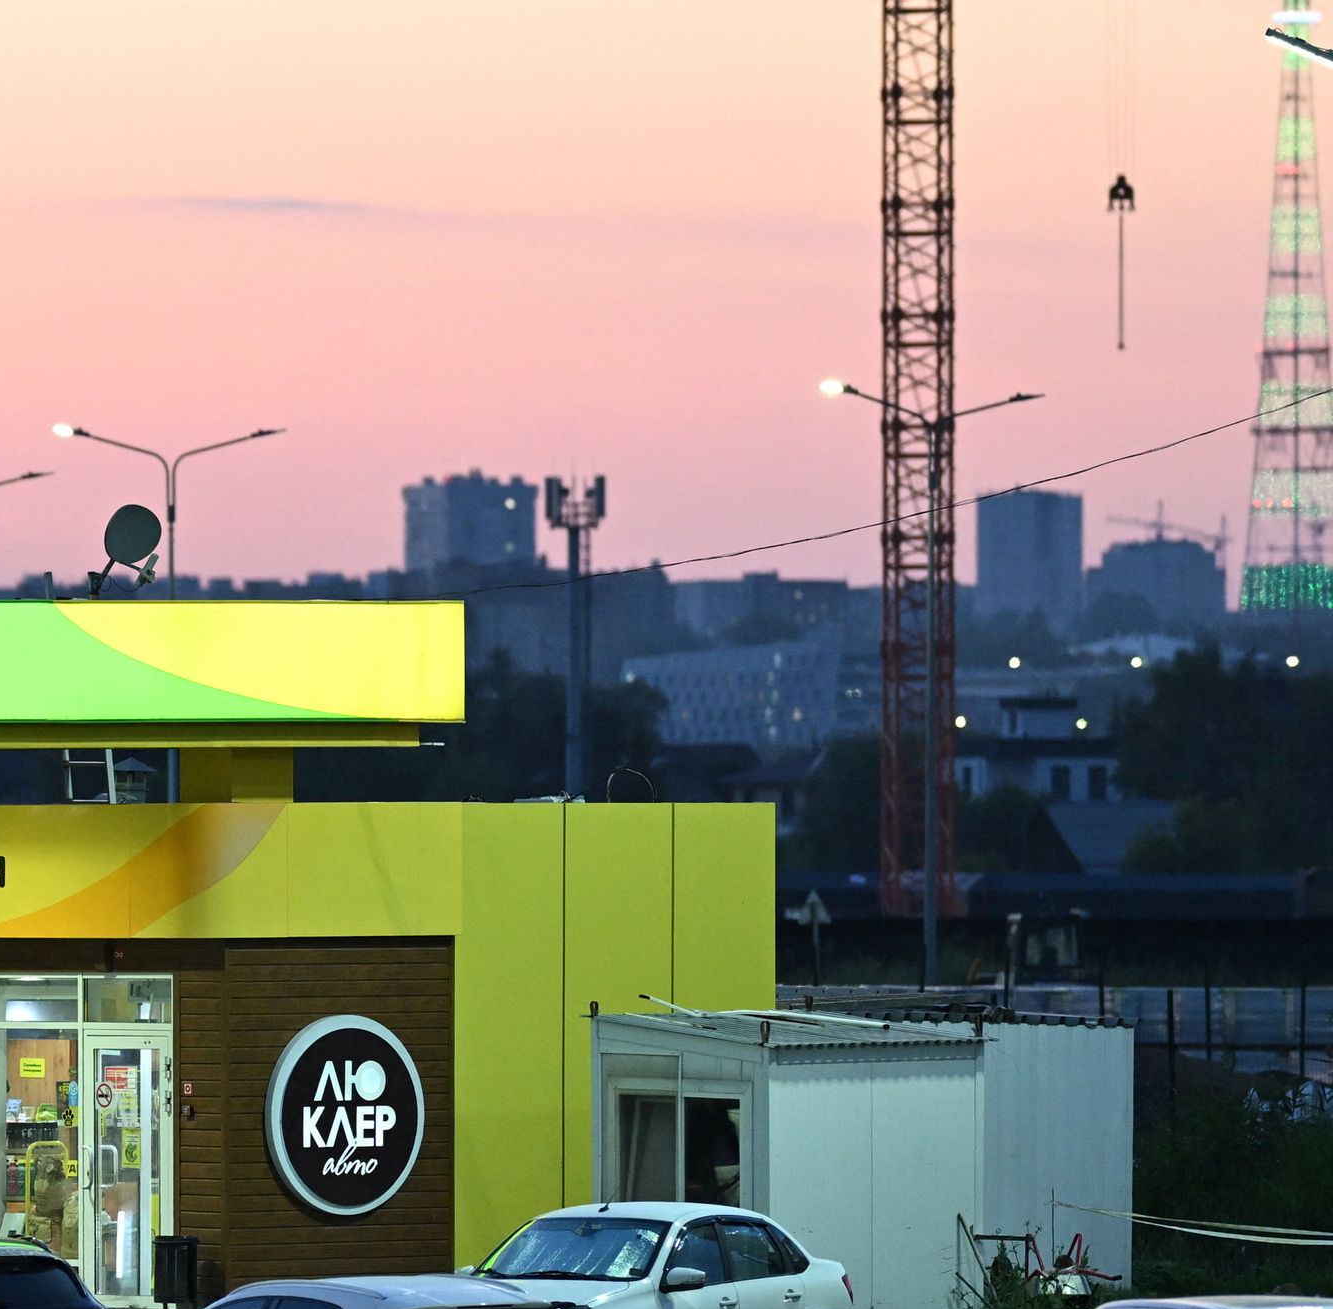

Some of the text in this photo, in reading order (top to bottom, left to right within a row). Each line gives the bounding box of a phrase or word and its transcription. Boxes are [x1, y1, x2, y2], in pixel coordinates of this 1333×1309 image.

[313, 1060, 387, 1101] ЛЮ
[303, 1105, 397, 1148] КЛЕР
[322, 1140, 378, 1176] авто
